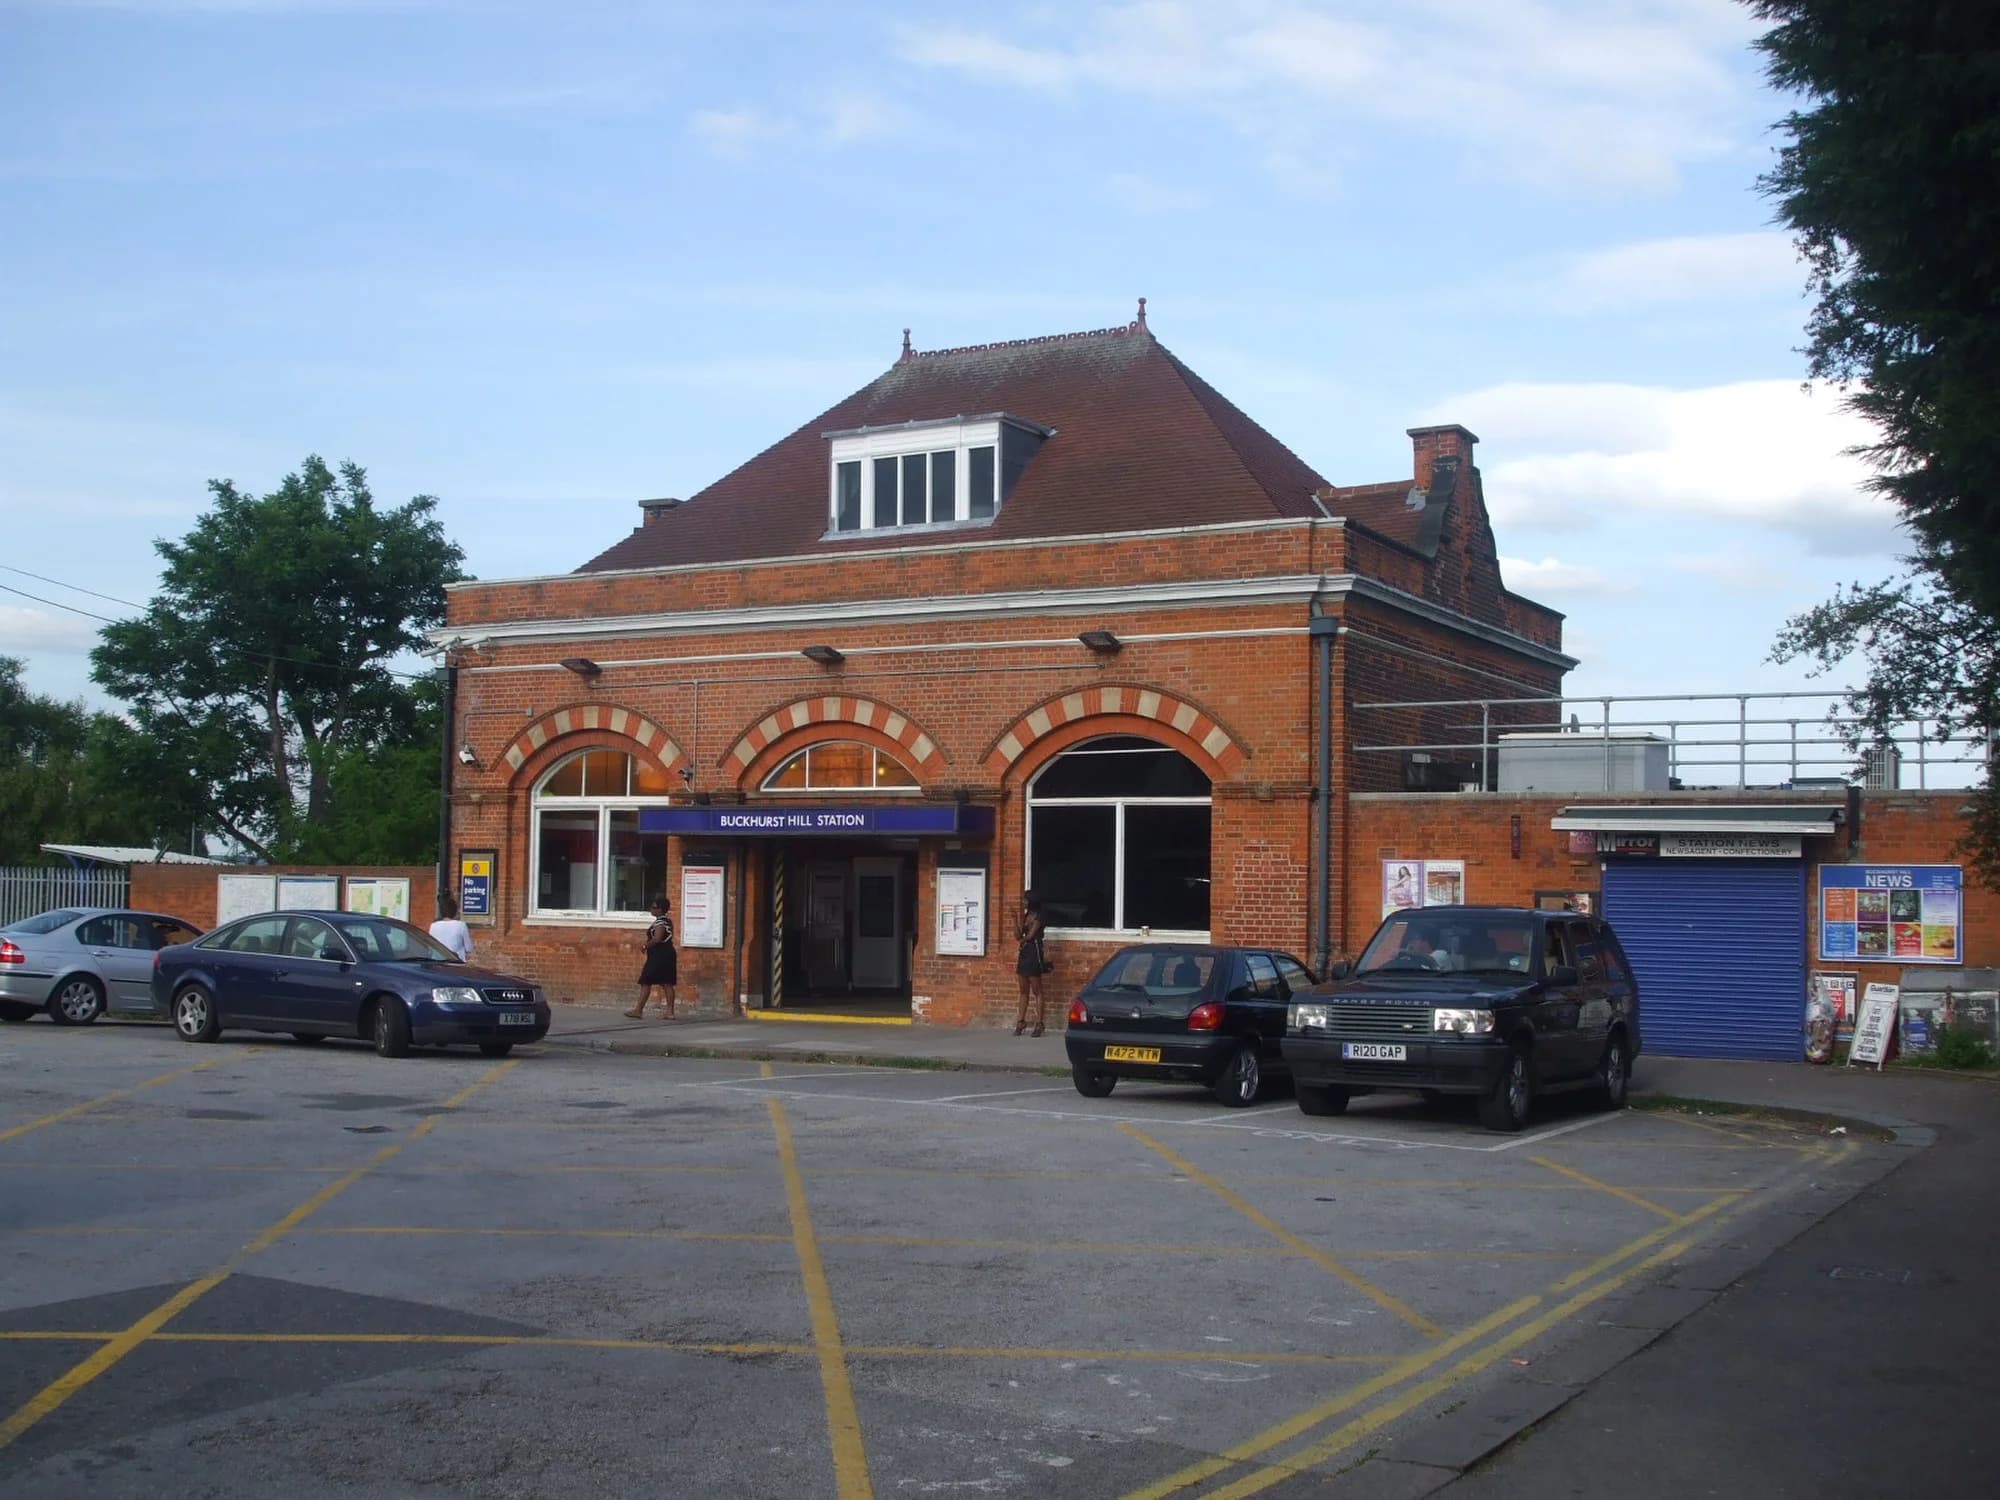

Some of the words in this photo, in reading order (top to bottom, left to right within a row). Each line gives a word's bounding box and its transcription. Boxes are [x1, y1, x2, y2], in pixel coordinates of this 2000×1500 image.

[720, 815, 785, 827] BUCKHURST
[787, 814, 813, 826] HILL
[817, 814, 865, 826] STATION
[1678, 839, 1734, 848] STATION
[1739, 839, 1780, 848] NEWS
[1666, 847, 1716, 855] NEWSAGENT
[1723, 847, 1793, 856] CONFECTIONERY
[464, 878, 475, 886] No
[1865, 875, 1913, 888] NEWS
[464, 887, 486, 896] parking
[1353, 1045, 1377, 1057] R120
[1380, 1046, 1402, 1059] GAP
